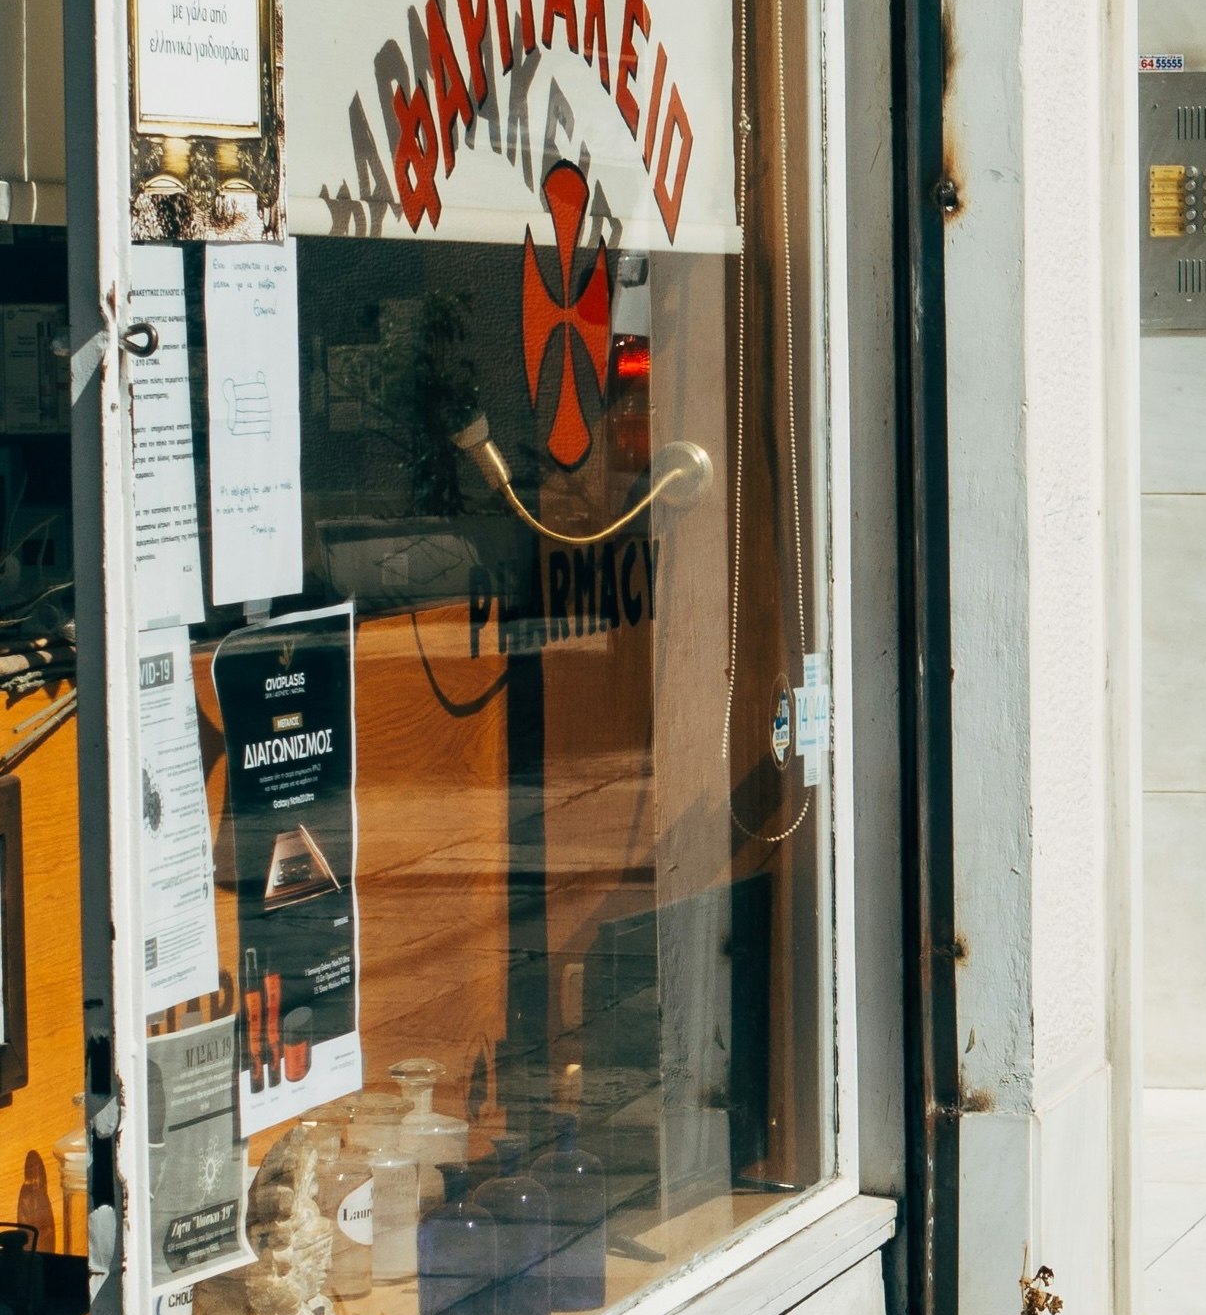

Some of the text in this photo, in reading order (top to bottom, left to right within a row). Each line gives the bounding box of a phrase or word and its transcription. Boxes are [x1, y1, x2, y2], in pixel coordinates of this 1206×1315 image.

[172, 0, 227, 26] με γάλα από
[469, 539, 660, 659] PHARMACY
[243, 729, 333, 769] ΔΙΑΓΩΝΙΣΜΟΣ
